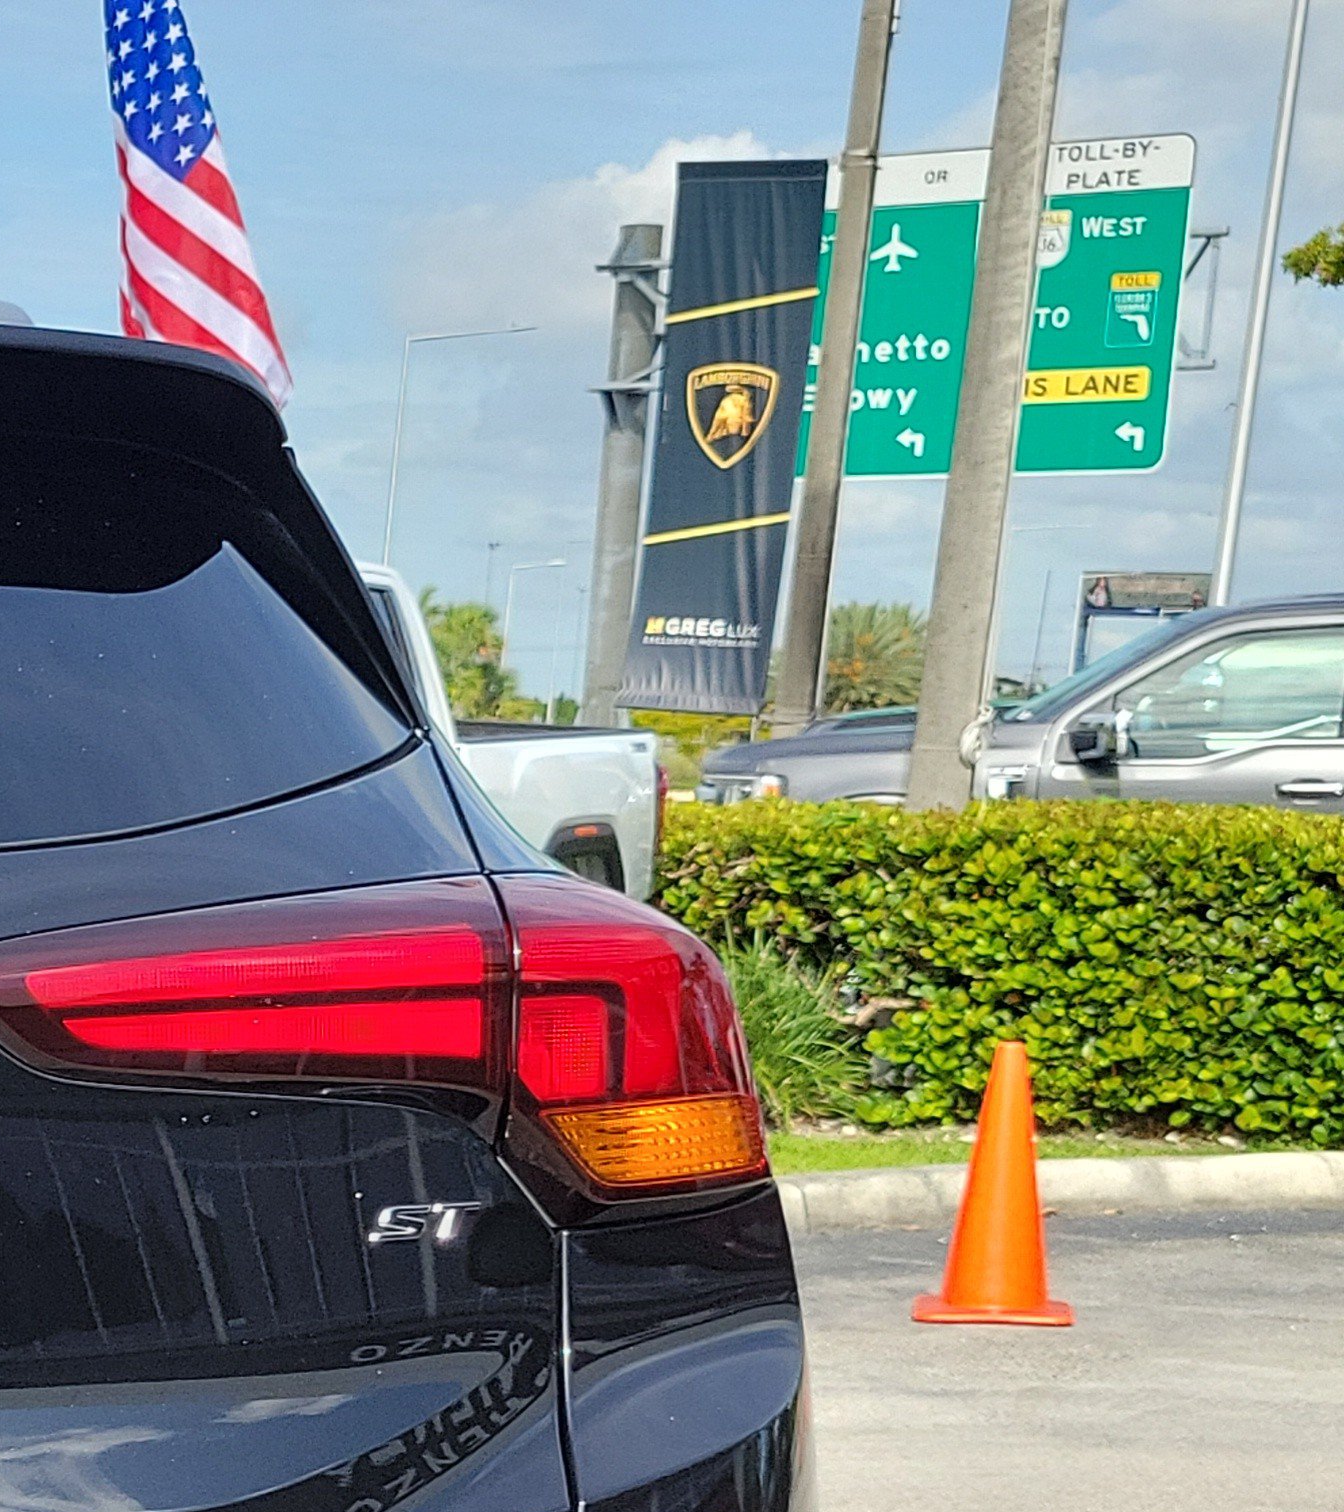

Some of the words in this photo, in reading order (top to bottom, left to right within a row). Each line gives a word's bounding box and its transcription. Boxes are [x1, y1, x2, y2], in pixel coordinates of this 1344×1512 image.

[924, 169, 950, 186] OR
[1065, 168, 1142, 190] PLATE
[1081, 216, 1148, 239] WEST
[1118, 274, 1152, 288] TOLL
[1033, 305, 1071, 329] TO
[1064, 373, 1140, 396] LANE
[367, 1200, 483, 1244] ST
